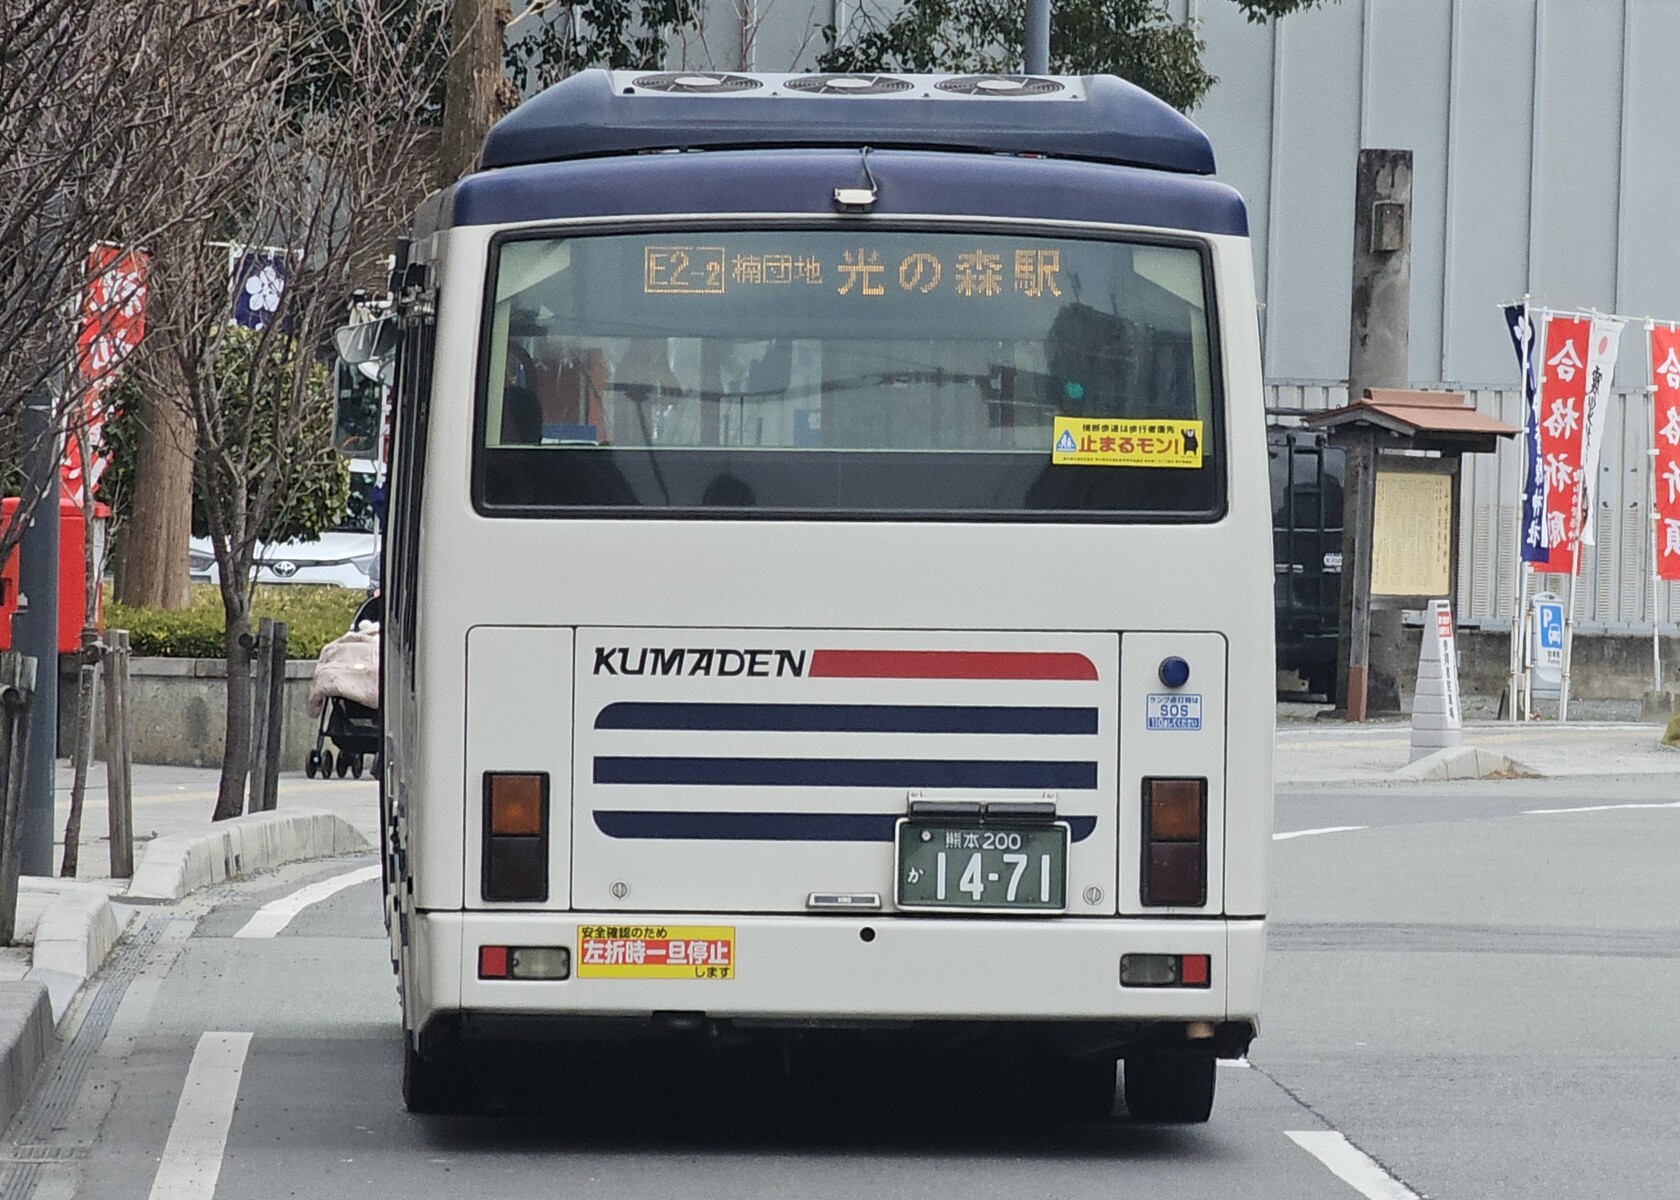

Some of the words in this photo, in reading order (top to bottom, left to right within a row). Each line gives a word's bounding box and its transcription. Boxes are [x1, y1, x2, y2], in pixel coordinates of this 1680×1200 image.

[731, 254, 822, 285] 楠団地
[837, 248, 1061, 298] 光の森駅
[1543, 608, 1553, 628] P
[593, 647, 806, 677] KUMADEN
[1160, 704, 1189, 717] SOS
[907, 866, 924, 884] か
[936, 852, 1051, 902] 14-71
[581, 926, 668, 939] 安全確認のため
[583, 939, 729, 965] 左折時一旦停止
[694, 966, 731, 978] します
